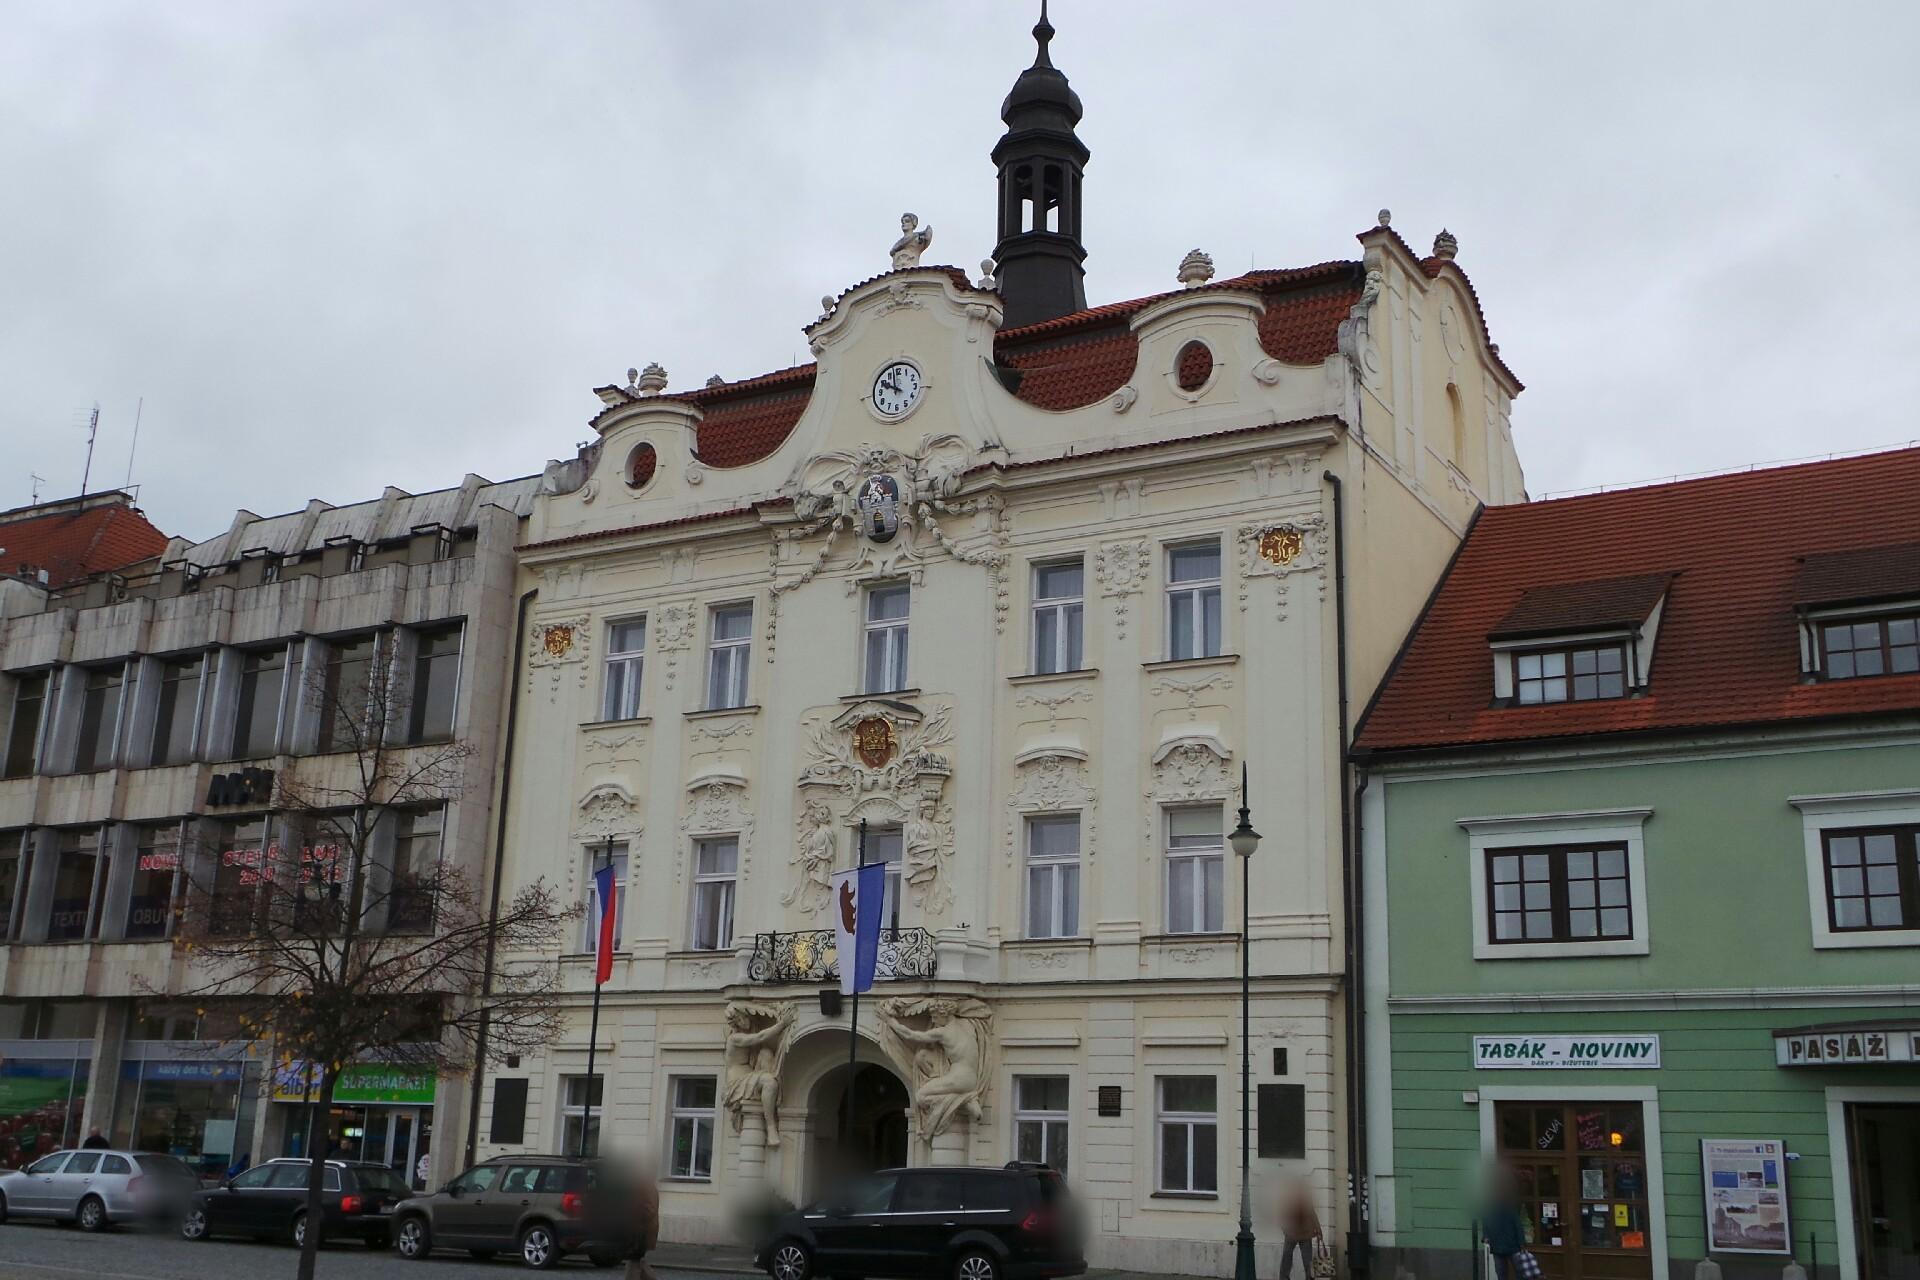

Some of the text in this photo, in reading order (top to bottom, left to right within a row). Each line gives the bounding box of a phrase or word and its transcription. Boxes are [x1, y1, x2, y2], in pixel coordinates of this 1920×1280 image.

[895, 367, 902, 376] 12
[1479, 1039, 1546, 1058] TABÁK
[1569, 1042, 1653, 1058] NOVINY
[1790, 1034, 1884, 1059] PASÁŽ
